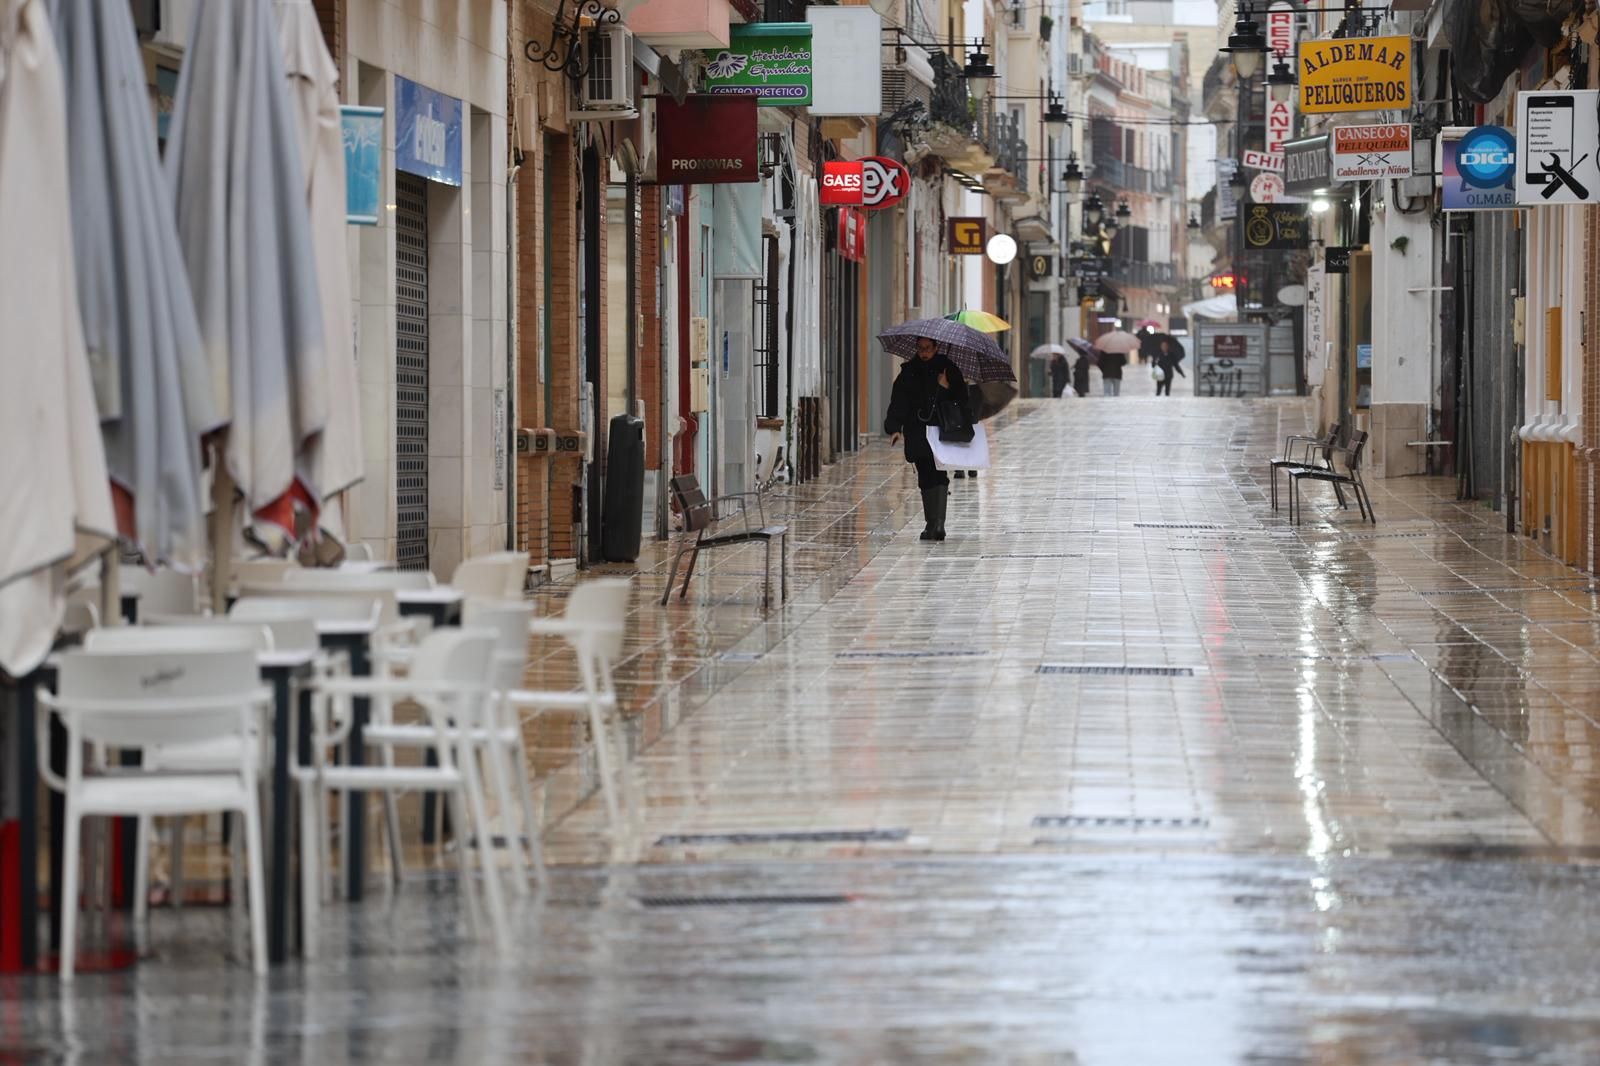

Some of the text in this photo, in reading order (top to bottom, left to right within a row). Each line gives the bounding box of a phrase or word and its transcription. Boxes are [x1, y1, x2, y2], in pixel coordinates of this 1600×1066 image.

[751, 46, 811, 61] Herbolario
[1303, 44, 1406, 75] ALDEMAR
[755, 87, 803, 96] DIETETICO
[1304, 81, 1406, 105] PELUQUEROS
[671, 159, 743, 170] PRONOVIAS
[1460, 152, 1515, 165] DIGI
[1336, 166, 1380, 177] Caballeros
[1380, 168, 1385, 177] y
[823, 174, 861, 187] GAES
